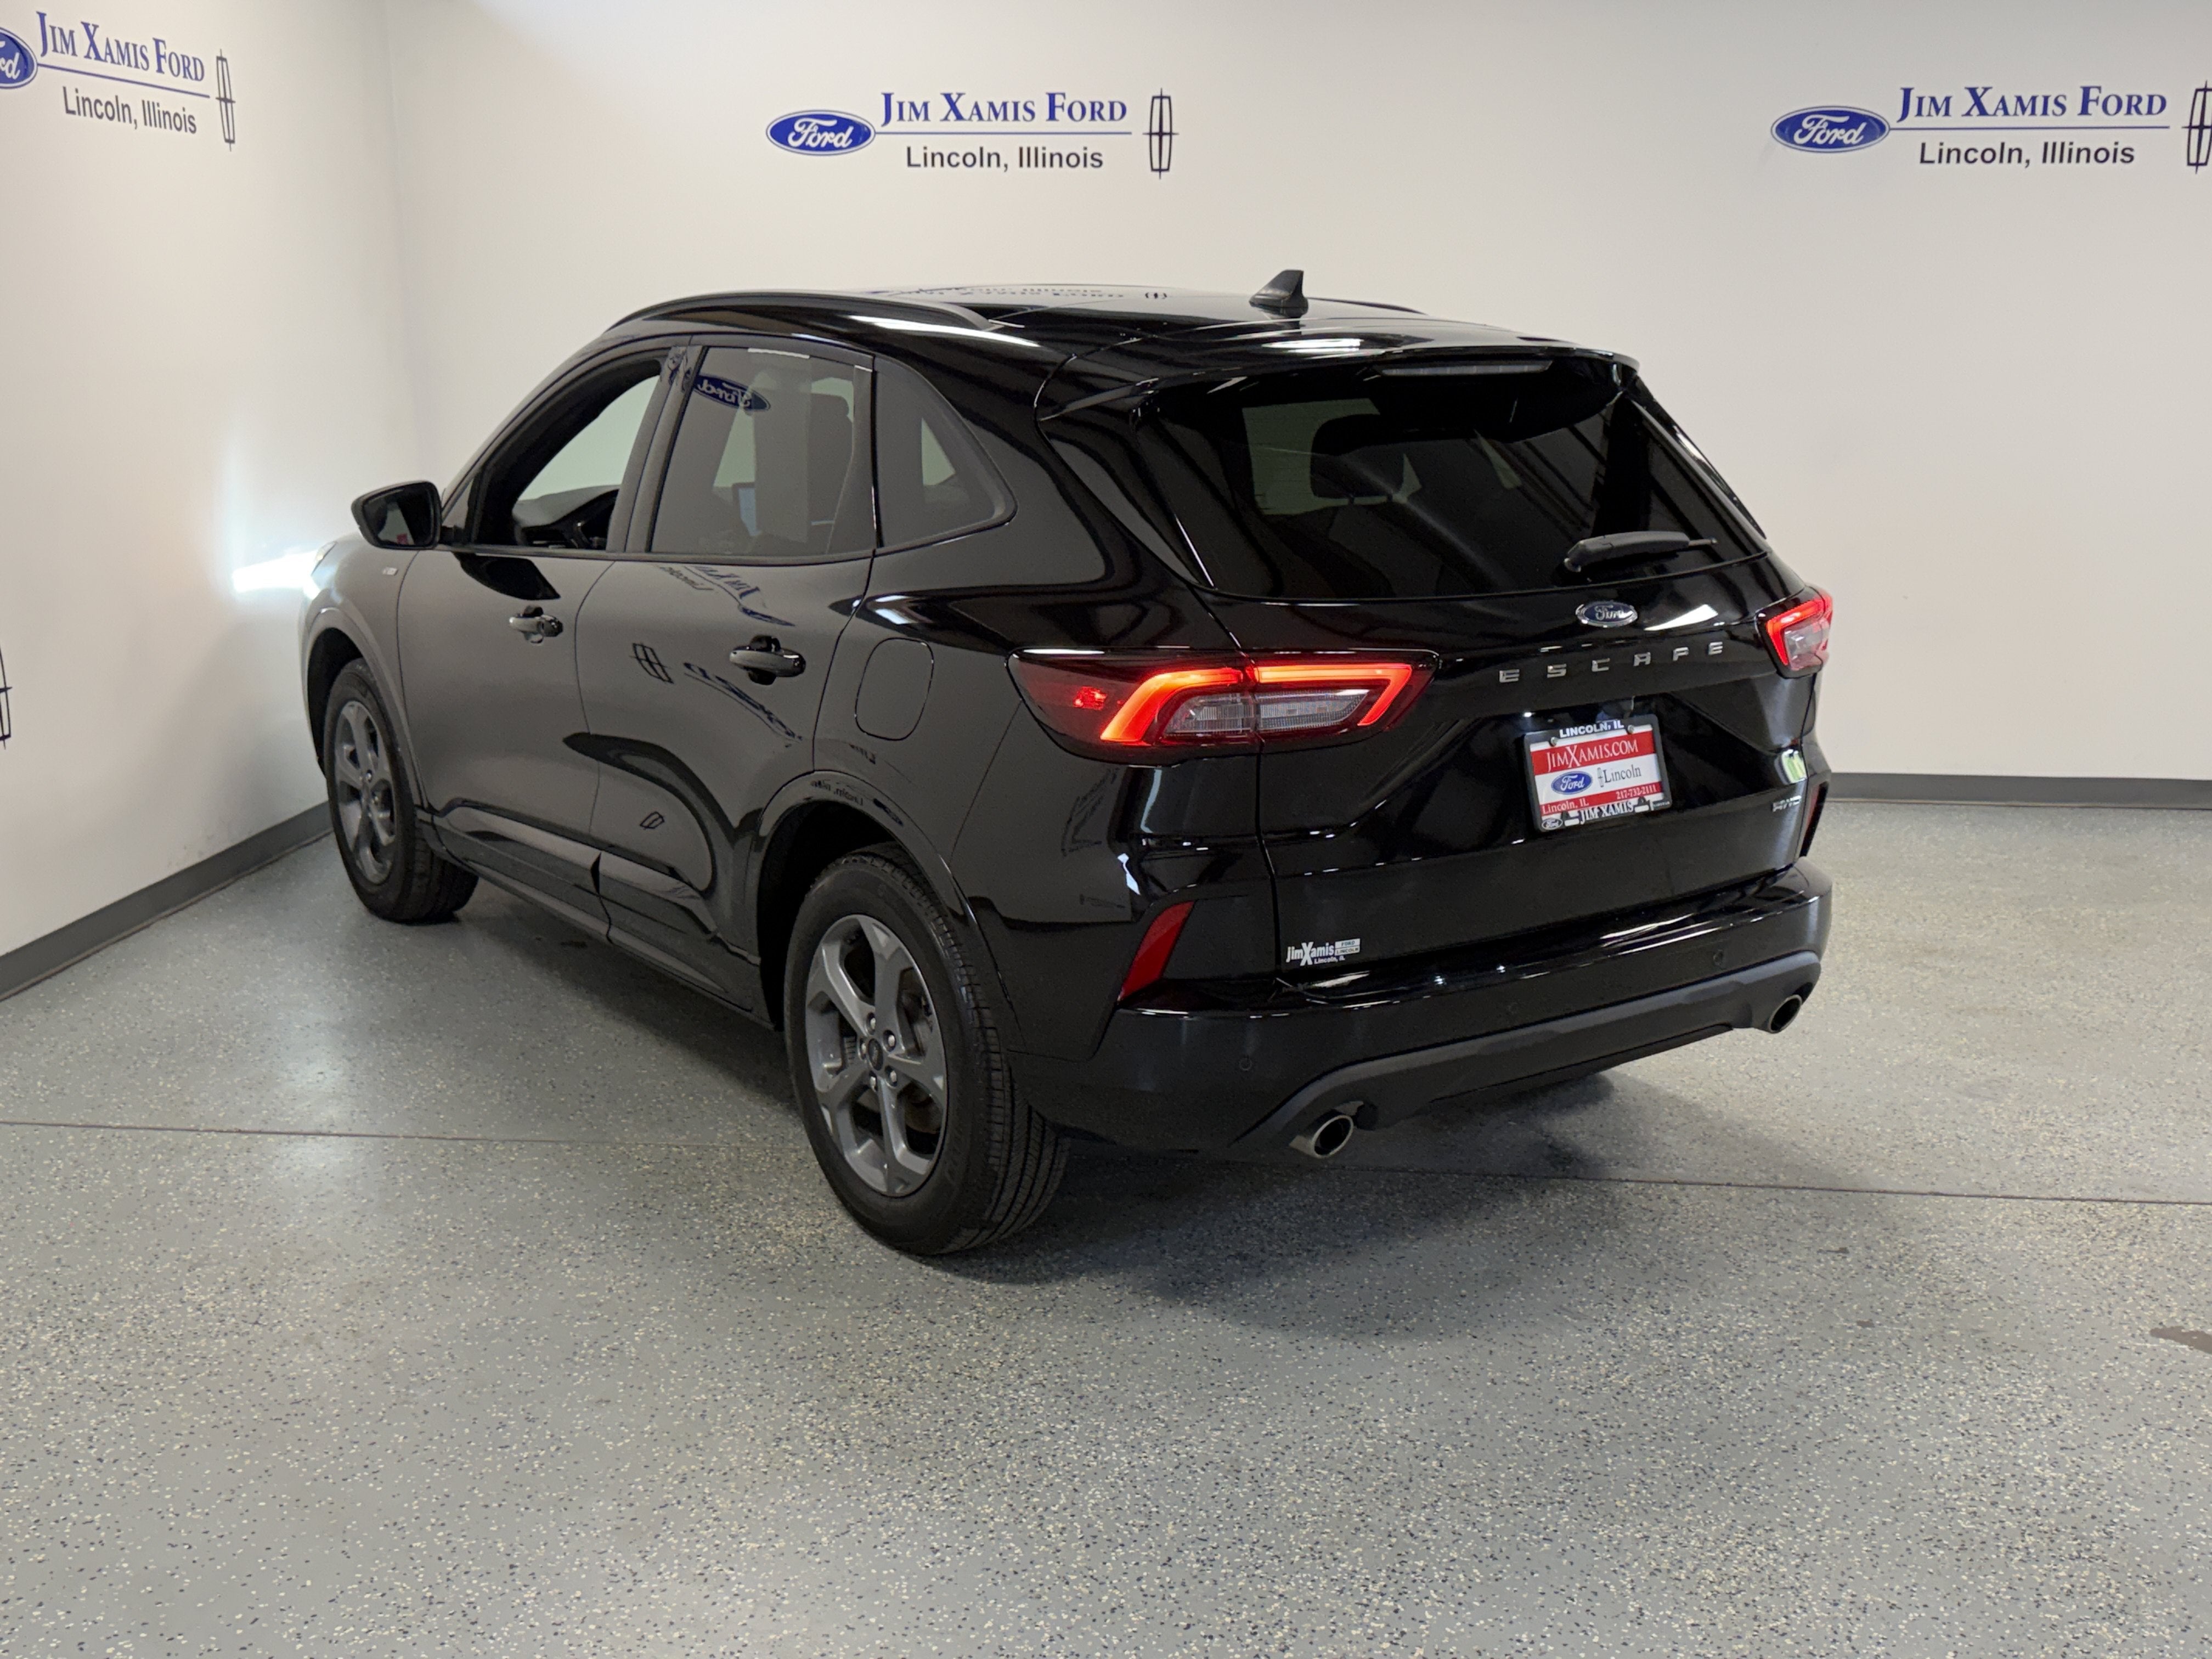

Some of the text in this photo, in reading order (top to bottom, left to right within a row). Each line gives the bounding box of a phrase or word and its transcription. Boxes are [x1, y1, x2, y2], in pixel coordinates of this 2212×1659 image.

[36, 11, 205, 82] JIM XAMIS FORD
[63, 86, 197, 134] Lincoln, Illinois
[881, 92, 1127, 128] JIM XAMIS FORD
[1897, 86, 2167, 123] JIM XAMIS FORD
[788, 117, 853, 149] Ford
[1793, 114, 1865, 145] Ford
[906, 146, 1103, 172] Lincoln, Illinois
[1920, 142, 2135, 168] Lincoln, Illinois
[1594, 605, 1634, 620] Ford
[1499, 641, 1723, 683] ESCAPE
[1559, 720, 1624, 738] LINCOLN, IL
[1560, 775, 1584, 790] Ford
[1604, 764, 1641, 783] Lincoln
[1579, 798, 1589, 807] IL
[1580, 802, 1634, 825] JIM XAMIS
